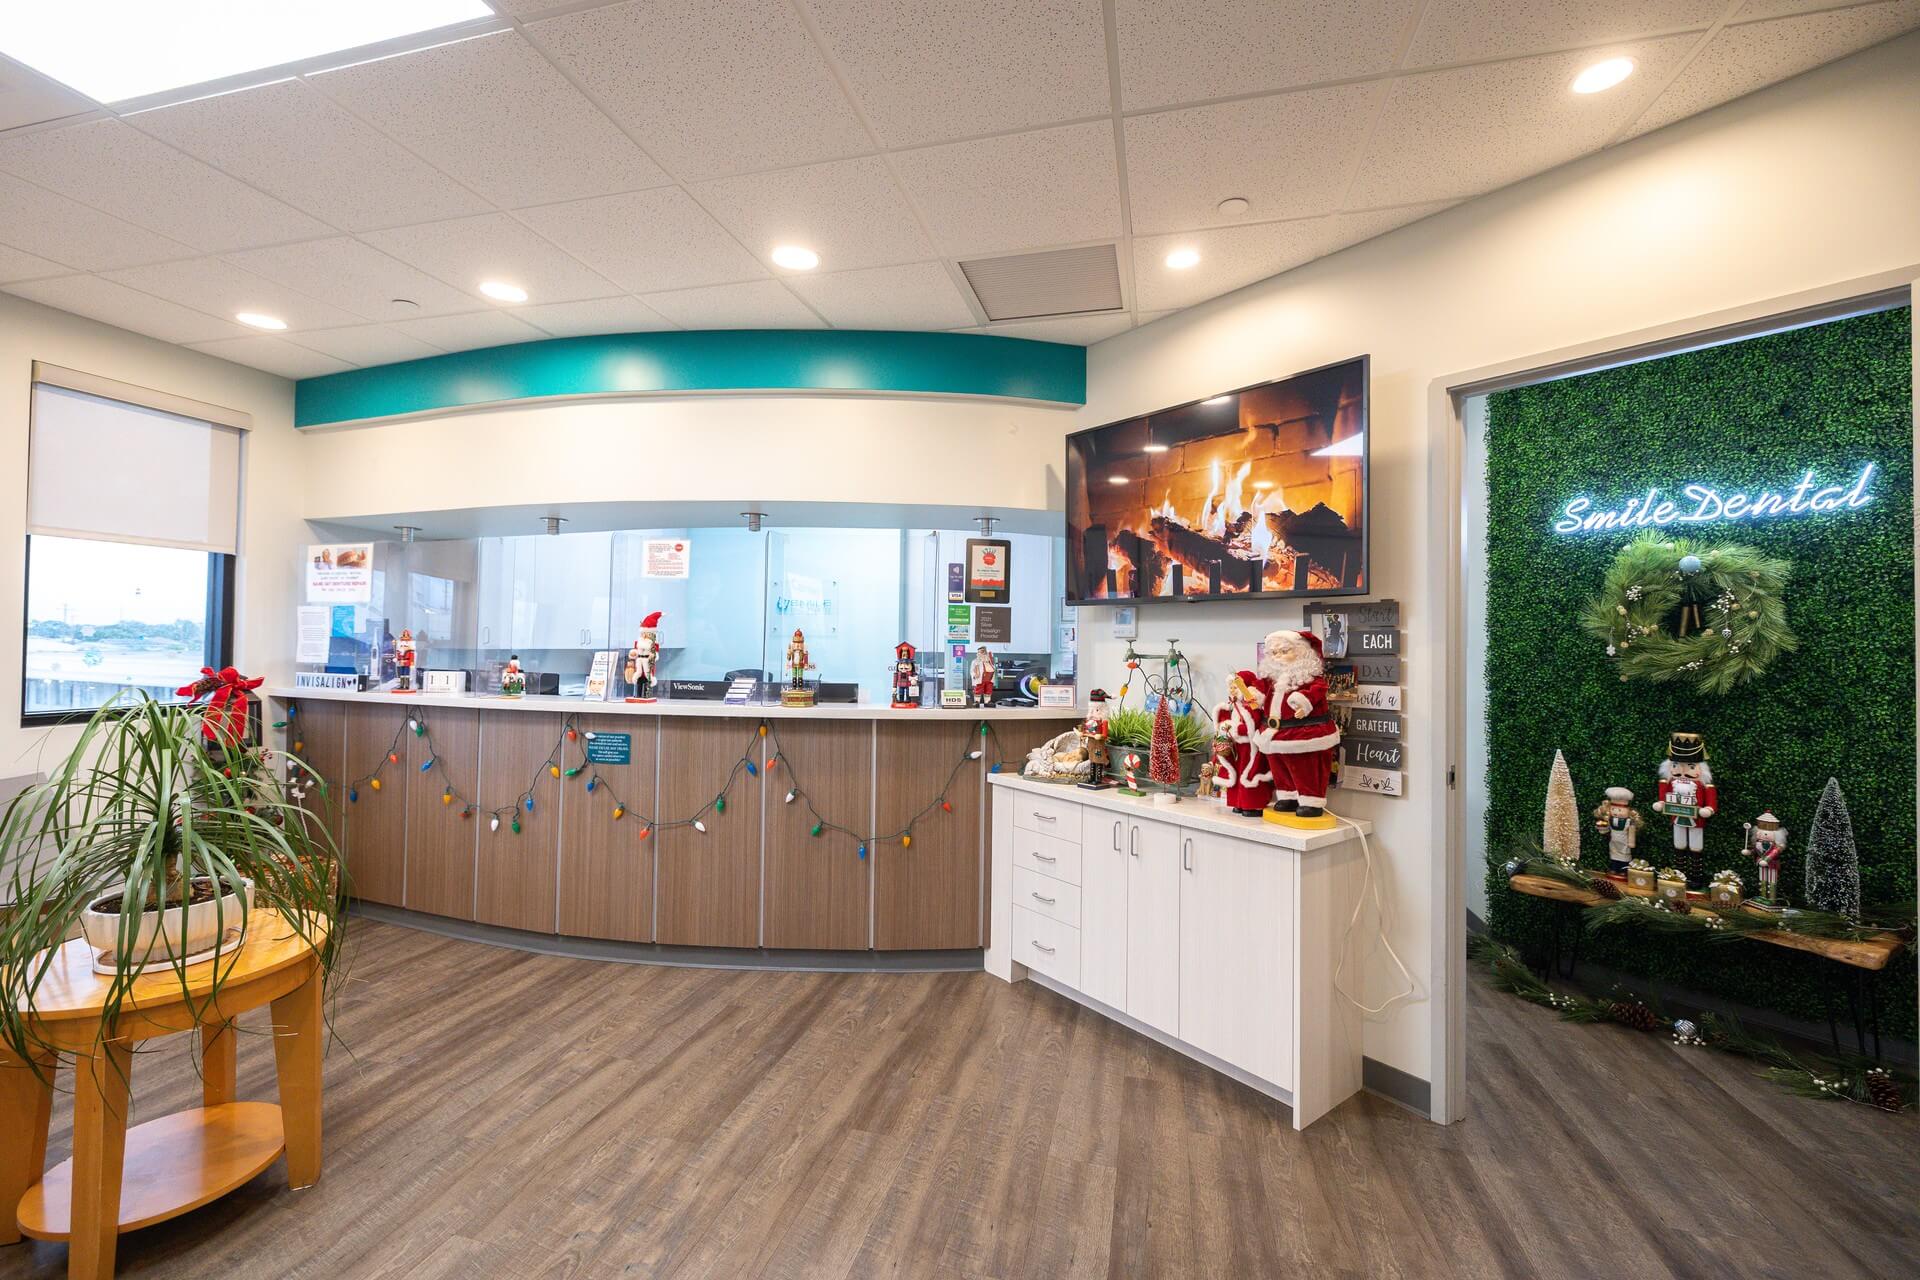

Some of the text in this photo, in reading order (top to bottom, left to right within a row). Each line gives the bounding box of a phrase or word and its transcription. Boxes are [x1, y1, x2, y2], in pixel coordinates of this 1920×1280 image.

[1555, 461, 1875, 534] Smile Dental
[1359, 606, 1394, 624] Start
[1363, 634, 1393, 649] EACH
[1362, 664, 1394, 678] DAY
[297, 674, 347, 689] INVISALIGN
[673, 683, 705, 691] ViewSonic
[1356, 691, 1397, 707] with a
[1357, 719, 1400, 733] GRATEFUL
[1357, 744, 1400, 763] Heart
